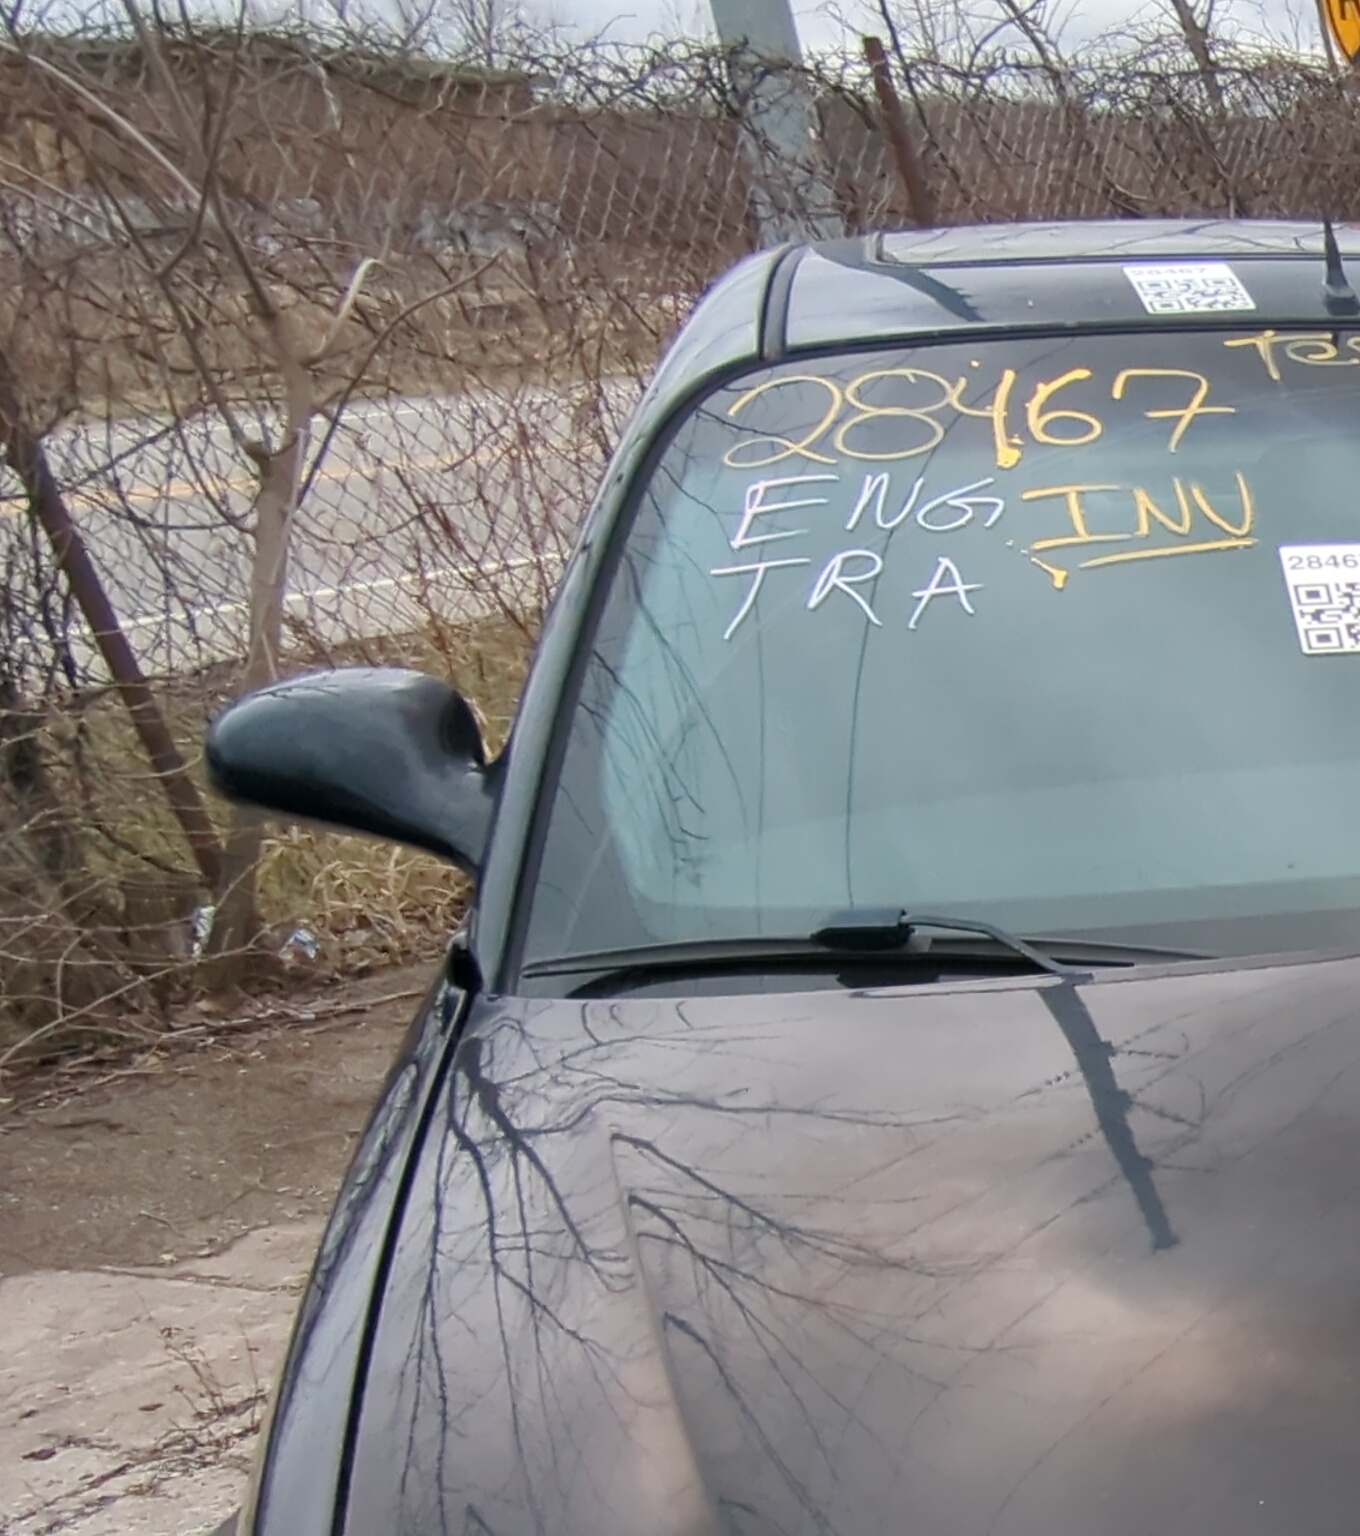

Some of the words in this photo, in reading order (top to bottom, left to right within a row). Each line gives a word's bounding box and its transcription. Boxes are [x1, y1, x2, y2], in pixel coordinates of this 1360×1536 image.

[723, 367, 1237, 469] 28467
[730, 472, 1006, 549] ENG
[1021, 471, 1256, 550] INV
[709, 548, 985, 641] TRA
